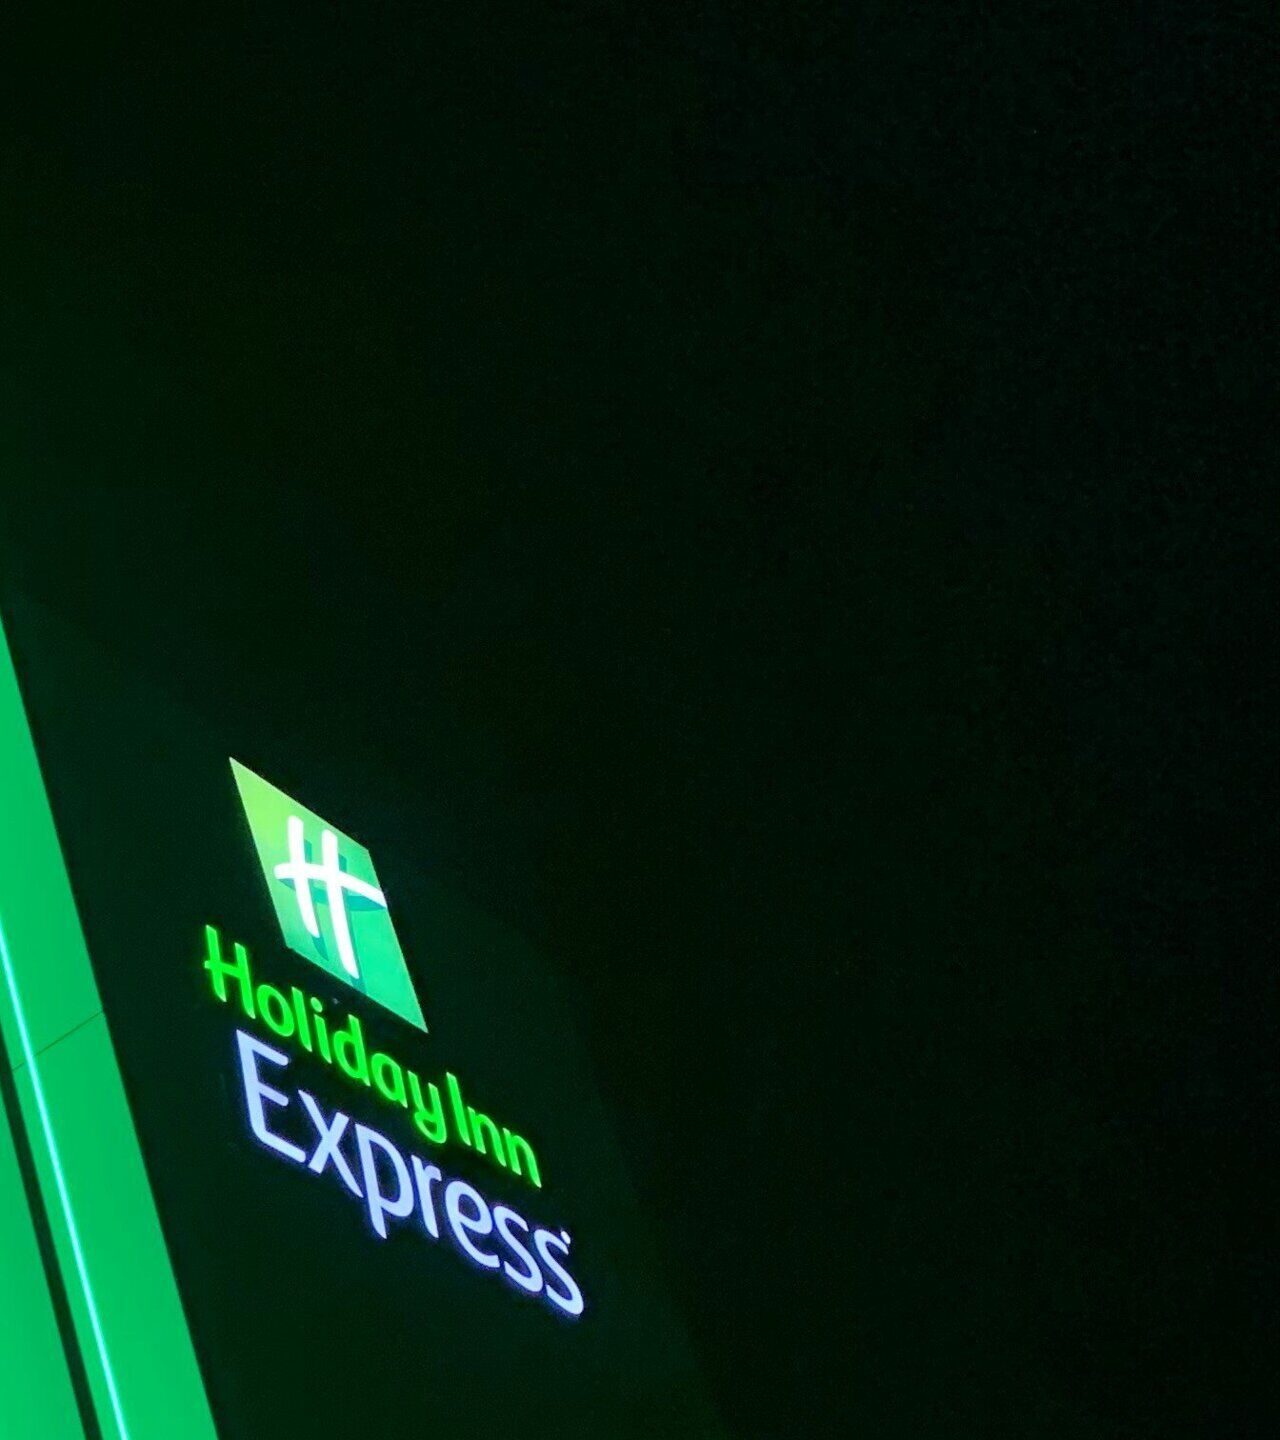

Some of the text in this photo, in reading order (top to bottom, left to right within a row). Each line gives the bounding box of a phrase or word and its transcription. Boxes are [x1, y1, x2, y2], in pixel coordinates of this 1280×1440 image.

[203, 924, 543, 1189] Holiday Inn
[236, 1029, 584, 1315] Express
